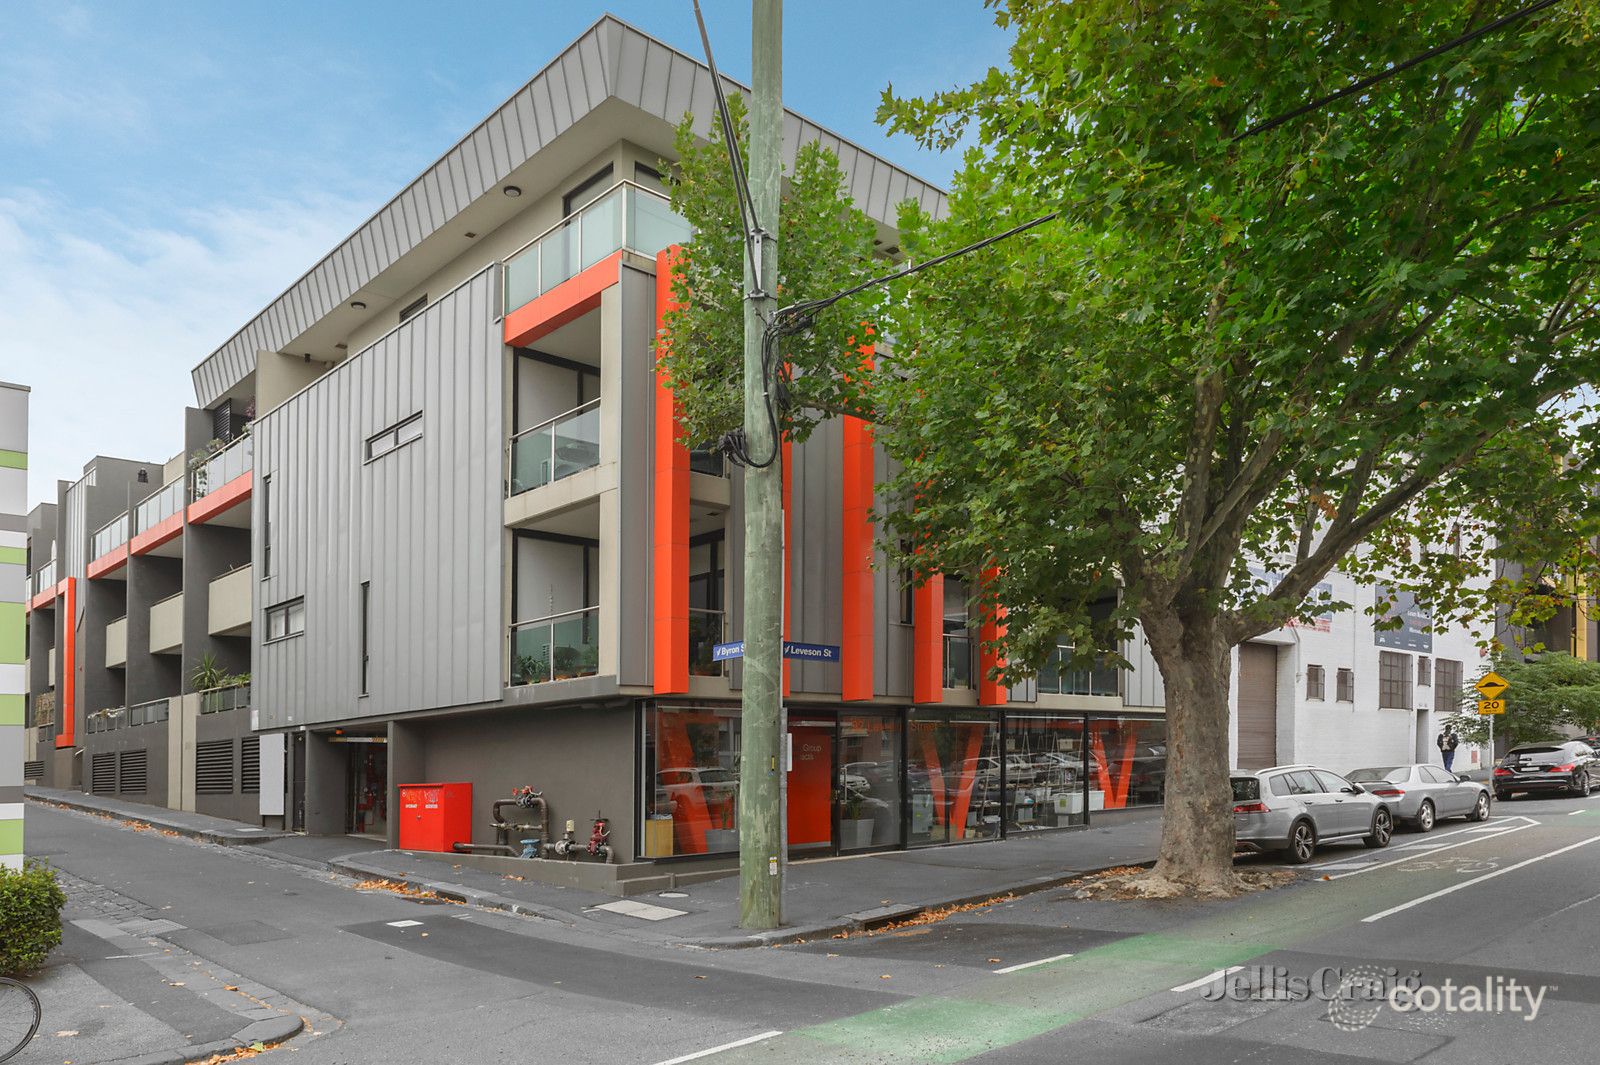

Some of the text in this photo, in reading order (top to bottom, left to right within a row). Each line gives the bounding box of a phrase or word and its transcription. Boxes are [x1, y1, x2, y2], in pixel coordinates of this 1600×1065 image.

[721, 646, 740, 657] Byron
[790, 646, 832, 658] Leveson St
[1483, 701, 1500, 709] 20
